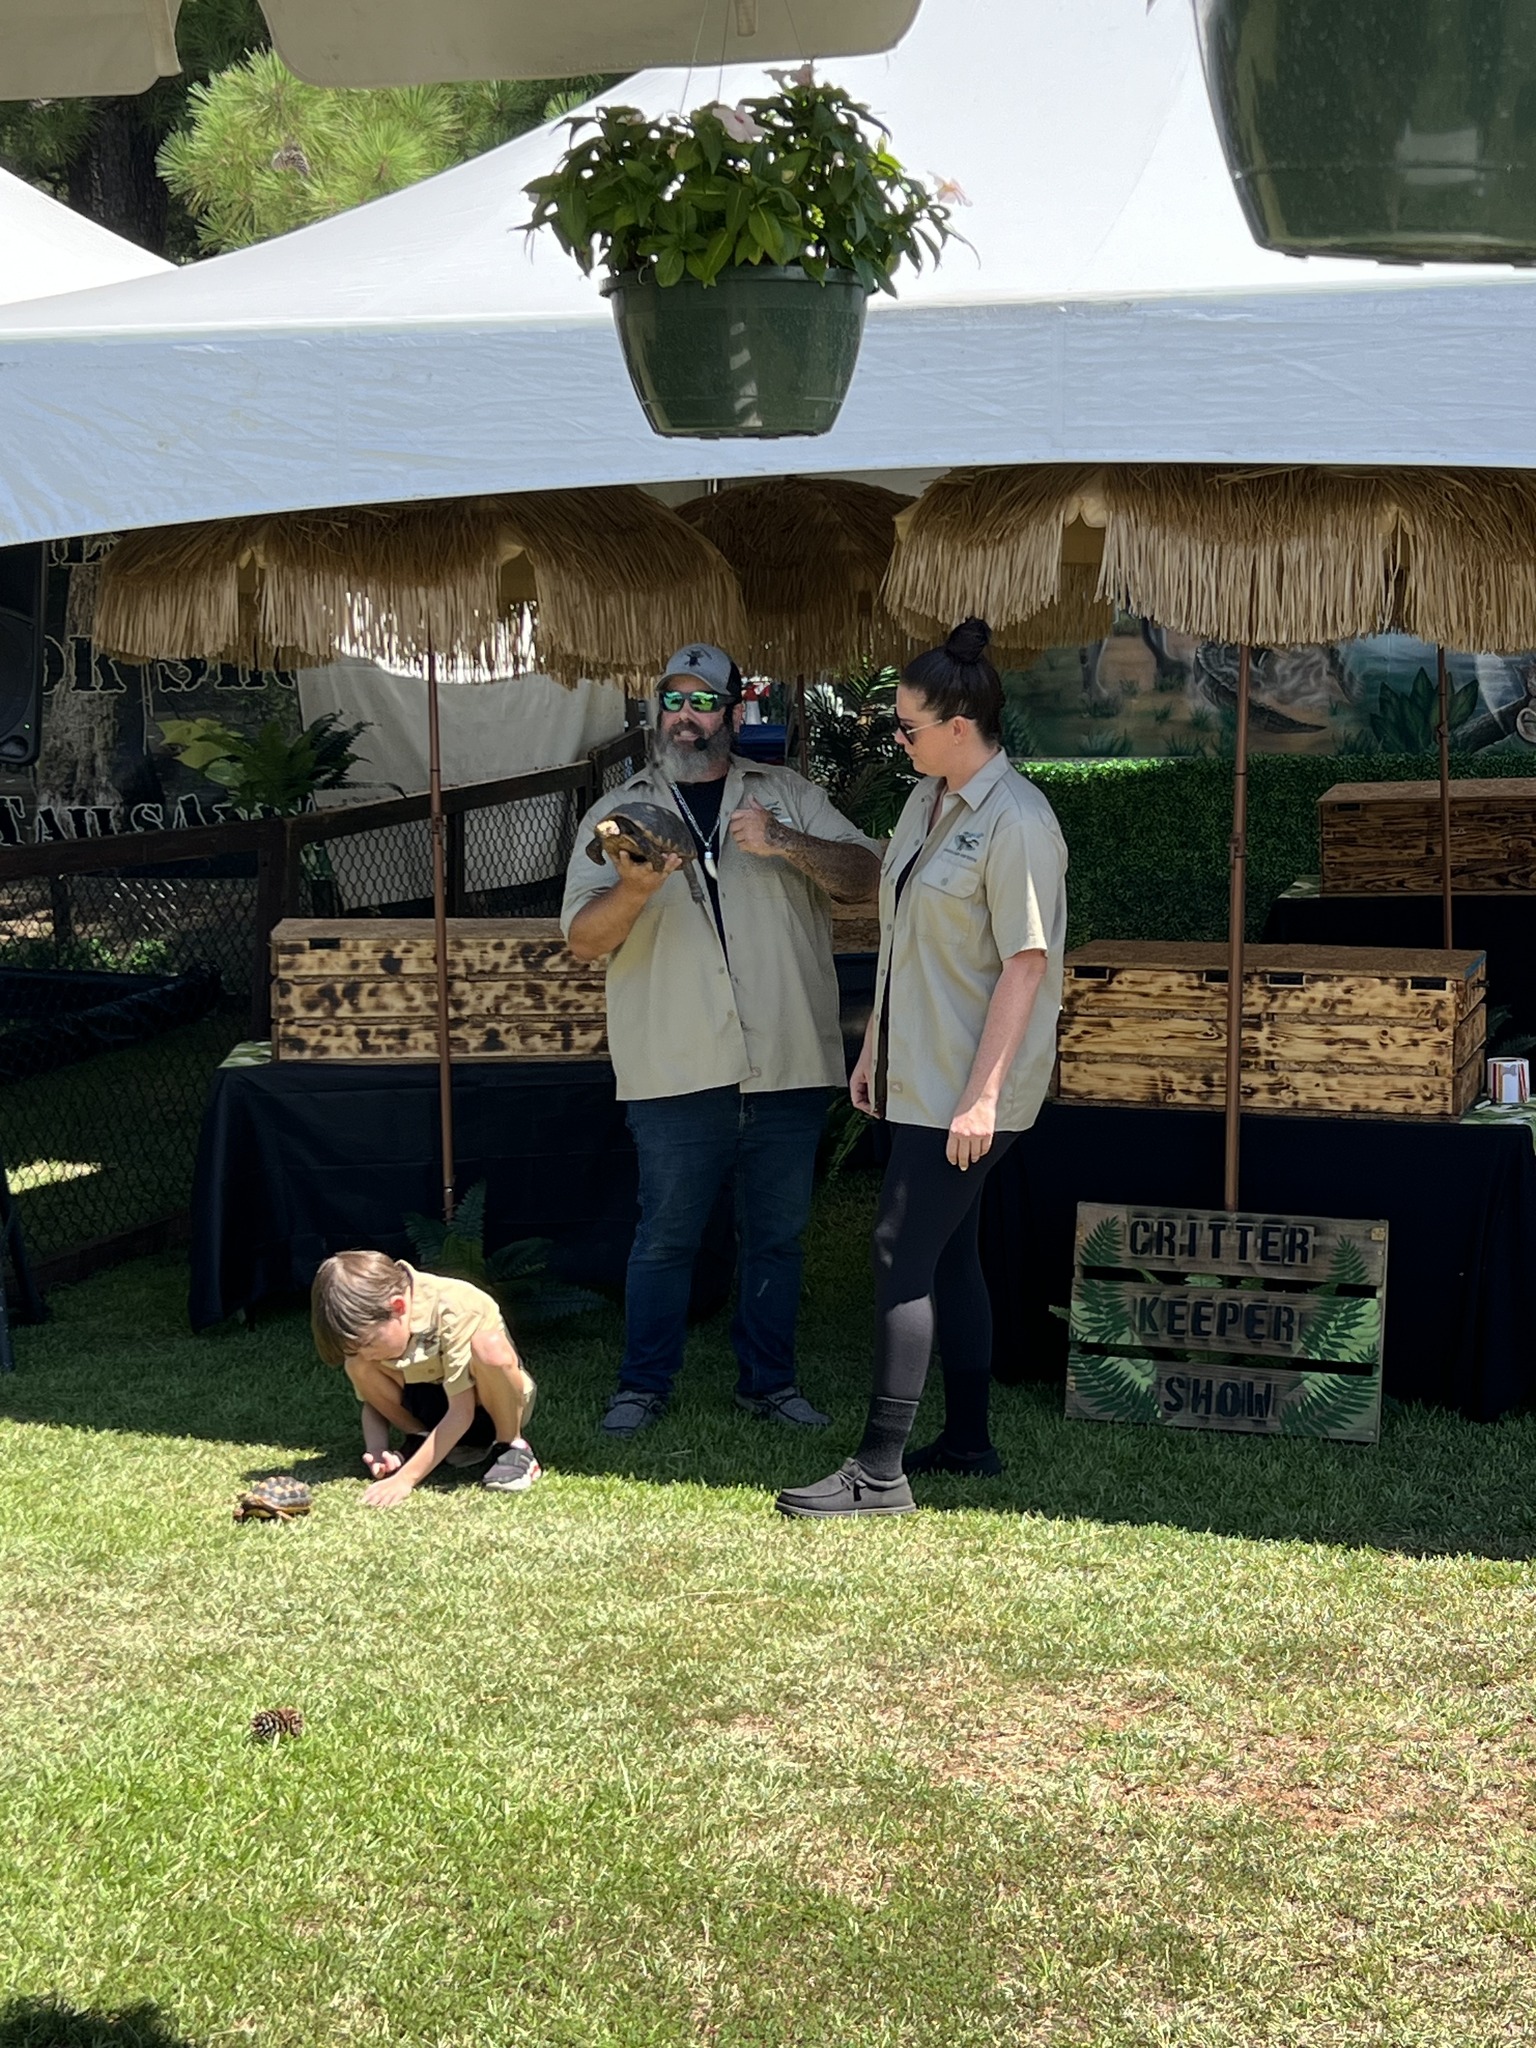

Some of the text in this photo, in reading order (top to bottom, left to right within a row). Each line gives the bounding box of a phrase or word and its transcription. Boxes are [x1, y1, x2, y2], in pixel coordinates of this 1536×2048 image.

[1129, 1219, 1311, 1264] CRITTER
[1137, 1296, 1296, 1343] KEEPER
[1163, 1376, 1273, 1419] SHOW
